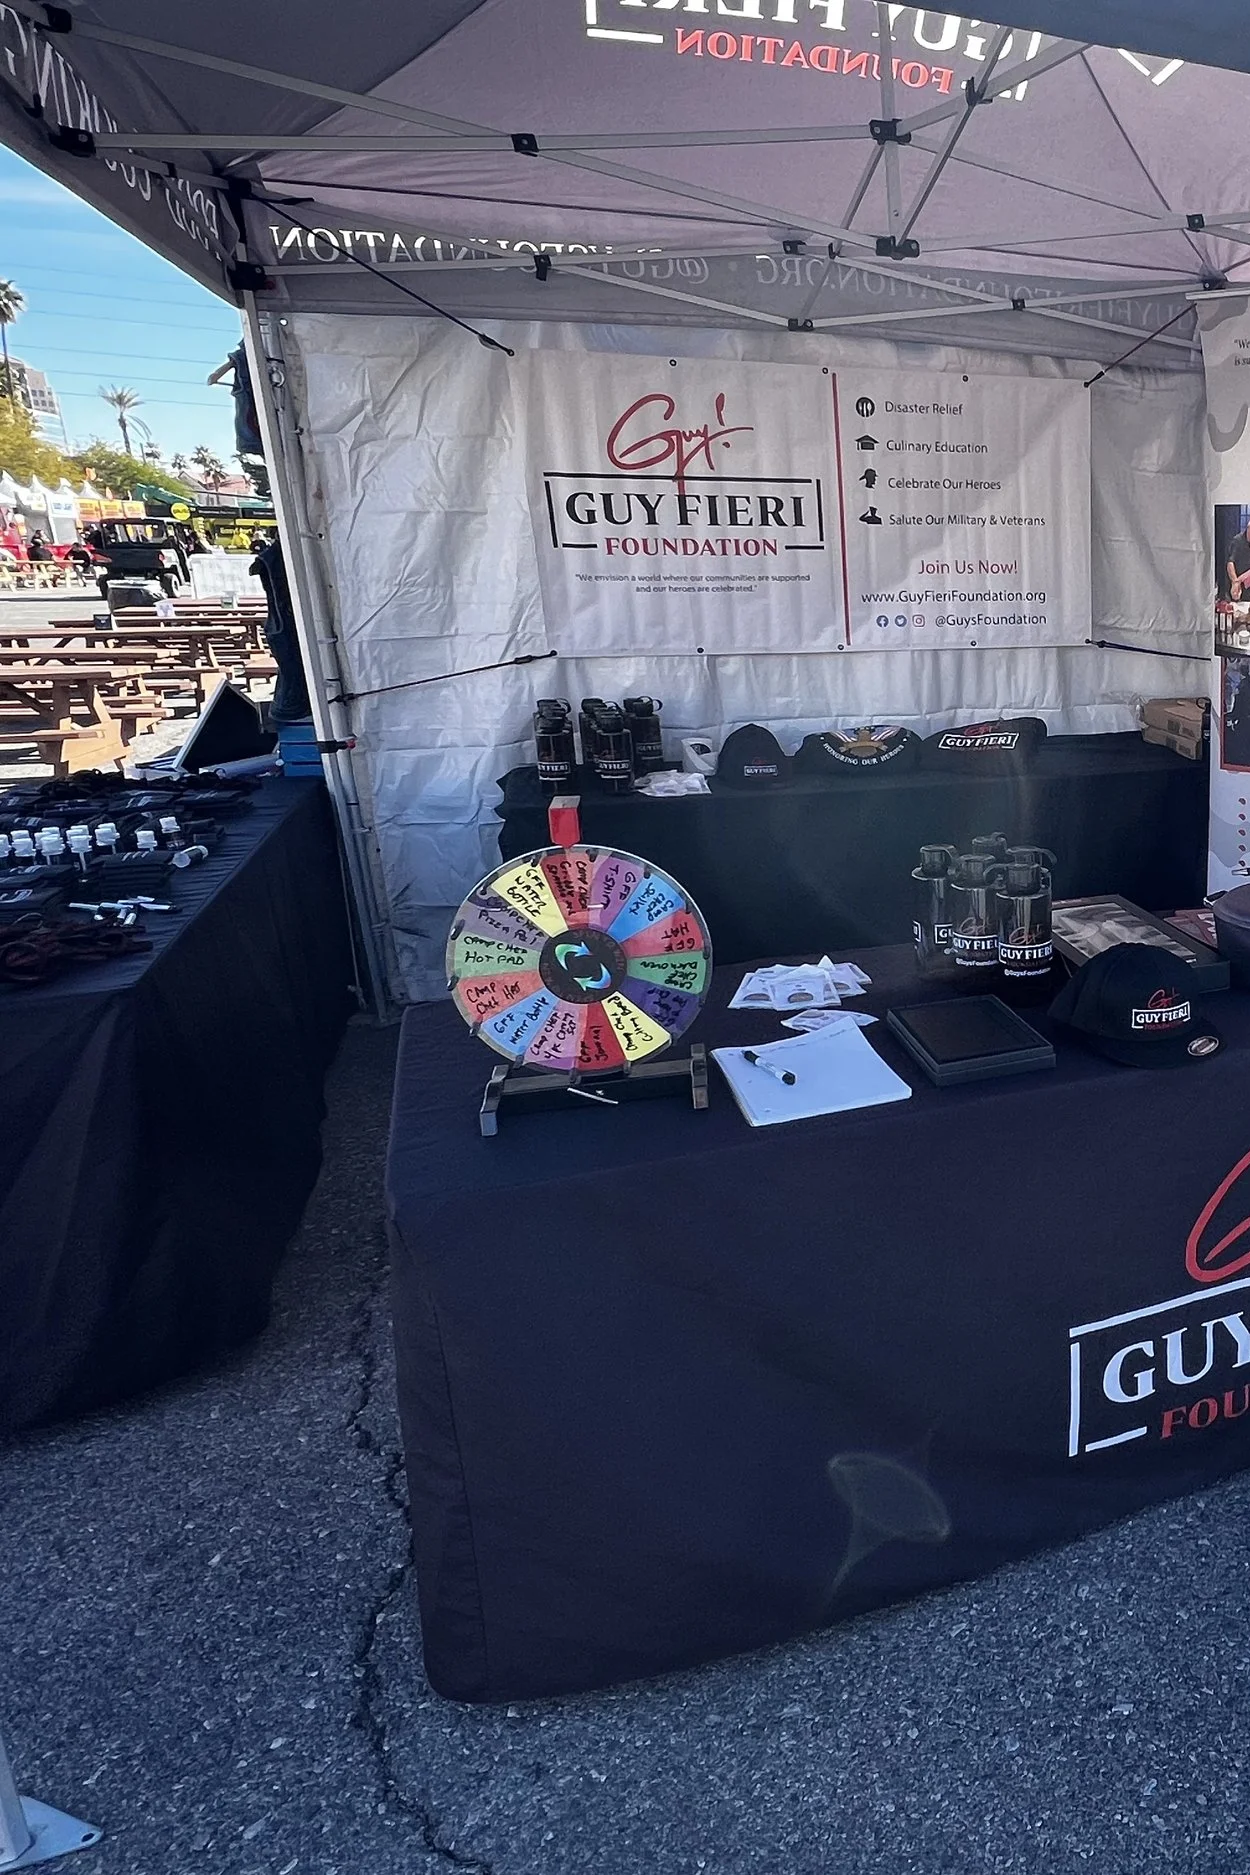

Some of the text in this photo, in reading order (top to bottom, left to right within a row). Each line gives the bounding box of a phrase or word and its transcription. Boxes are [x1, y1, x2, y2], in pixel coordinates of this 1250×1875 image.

[1234, 355, 1240, 366] is
[885, 401, 963, 416] Disaster Relief
[886, 440, 988, 455] Culinary Education
[888, 478, 1001, 490] Celebrate Our Heroes
[565, 492, 805, 527] GUY FIERI
[890, 514, 1046, 528] Salute Our Military & Veterans
[605, 537, 778, 556] FOUNDATION
[918, 560, 1018, 575] Join Us Now!
[638, 574, 661, 582] world
[662, 574, 688, 582] where
[705, 574, 756, 582] communities
[771, 574, 810, 584] supported
[861, 590, 1046, 604] www.GuyFieriFoundation.org
[935, 614, 1046, 628] @GuysFoundation
[945, 735, 1013, 748] GUY FIERI
[861, 758, 879, 766] OUR
[526, 869, 545, 890] GFF
[620, 872, 636, 900] GFF
[662, 922, 689, 939] HAT
[465, 951, 524, 965] HOT PAD
[1001, 947, 1024, 960] GUY
[1136, 1006, 1187, 1023] GUY FIERI
[494, 1013, 516, 1033] GFF
